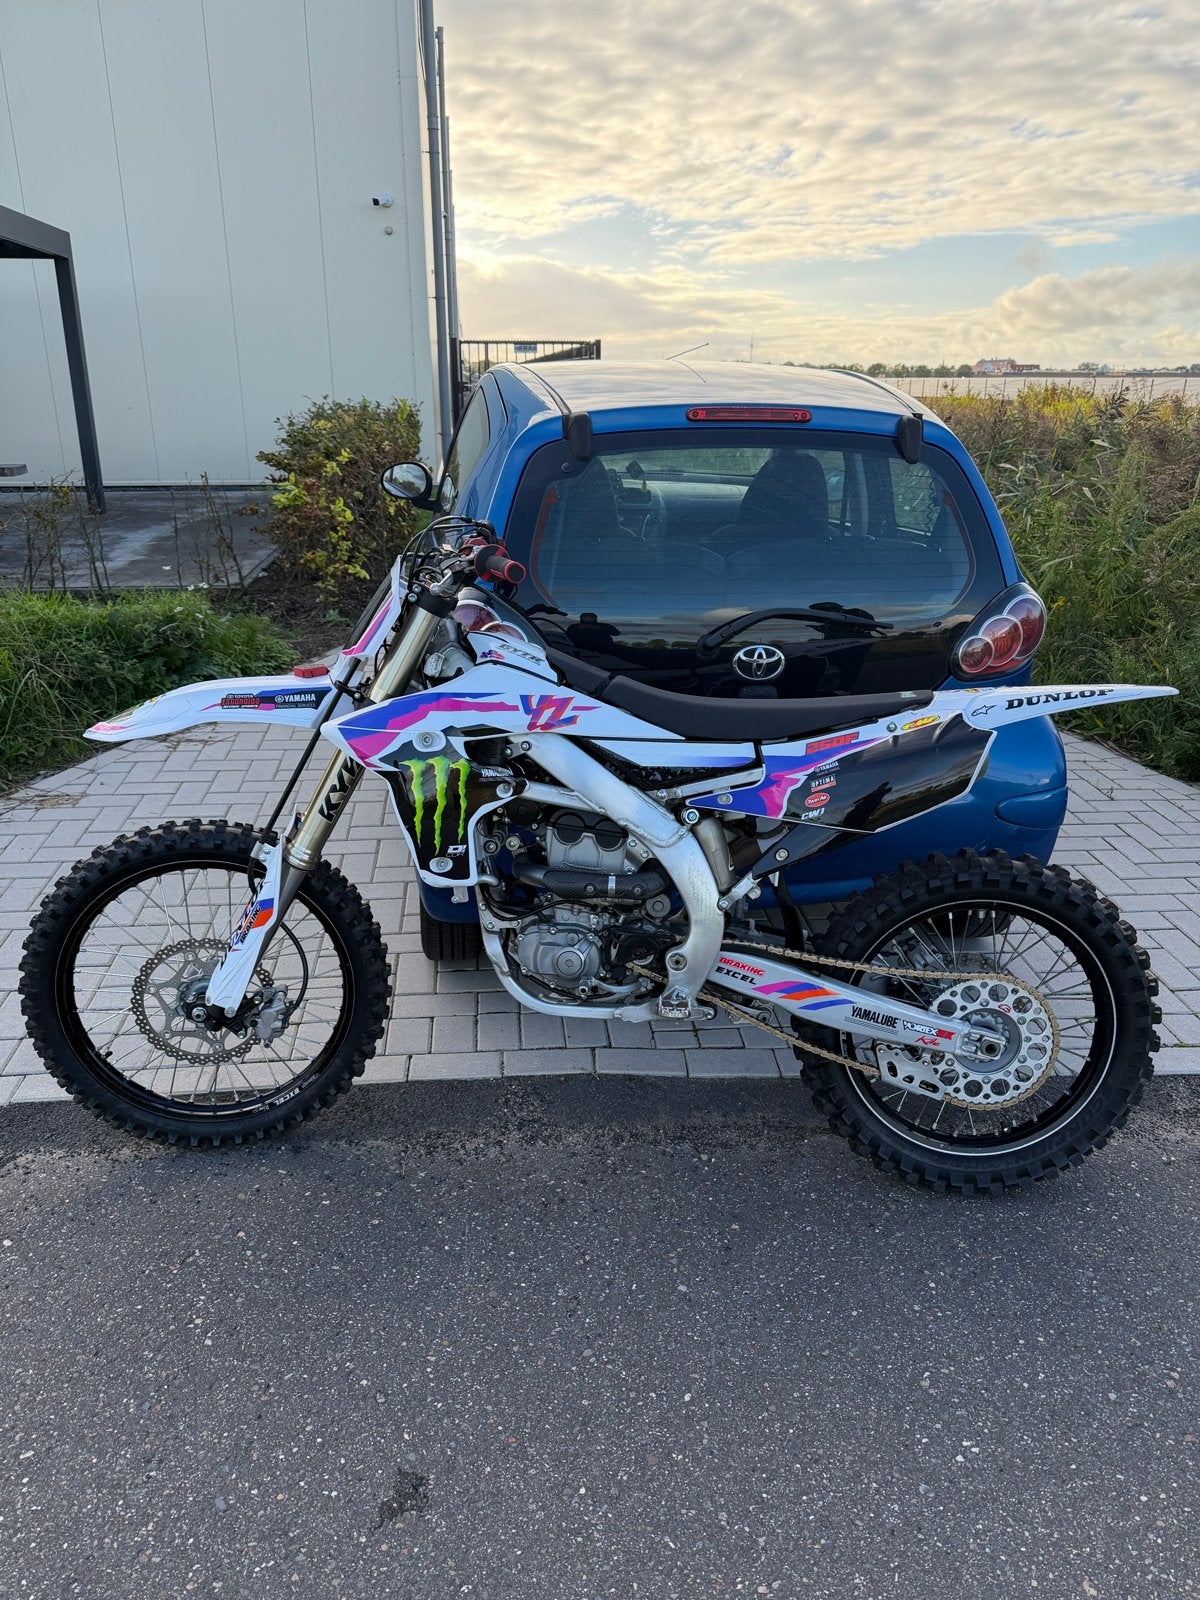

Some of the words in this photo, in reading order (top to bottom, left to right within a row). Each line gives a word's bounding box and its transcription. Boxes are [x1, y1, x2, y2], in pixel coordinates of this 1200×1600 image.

[284, 693, 316, 703] YAMAHA
[1005, 688, 1115, 710] DUNLOP
[519, 694, 580, 732] YZ
[805, 731, 860, 755] 250F
[811, 775, 835, 788] OPTIMA
[240, 905, 261, 945] BRAKING
[715, 966, 757, 985] EXCEL
[719, 956, 766, 977] BRAKING
[851, 1005, 899, 1029] YAMALUBE
[902, 1019, 939, 1037] VORTEX
[272, 1087, 301, 1106] EXCEL
